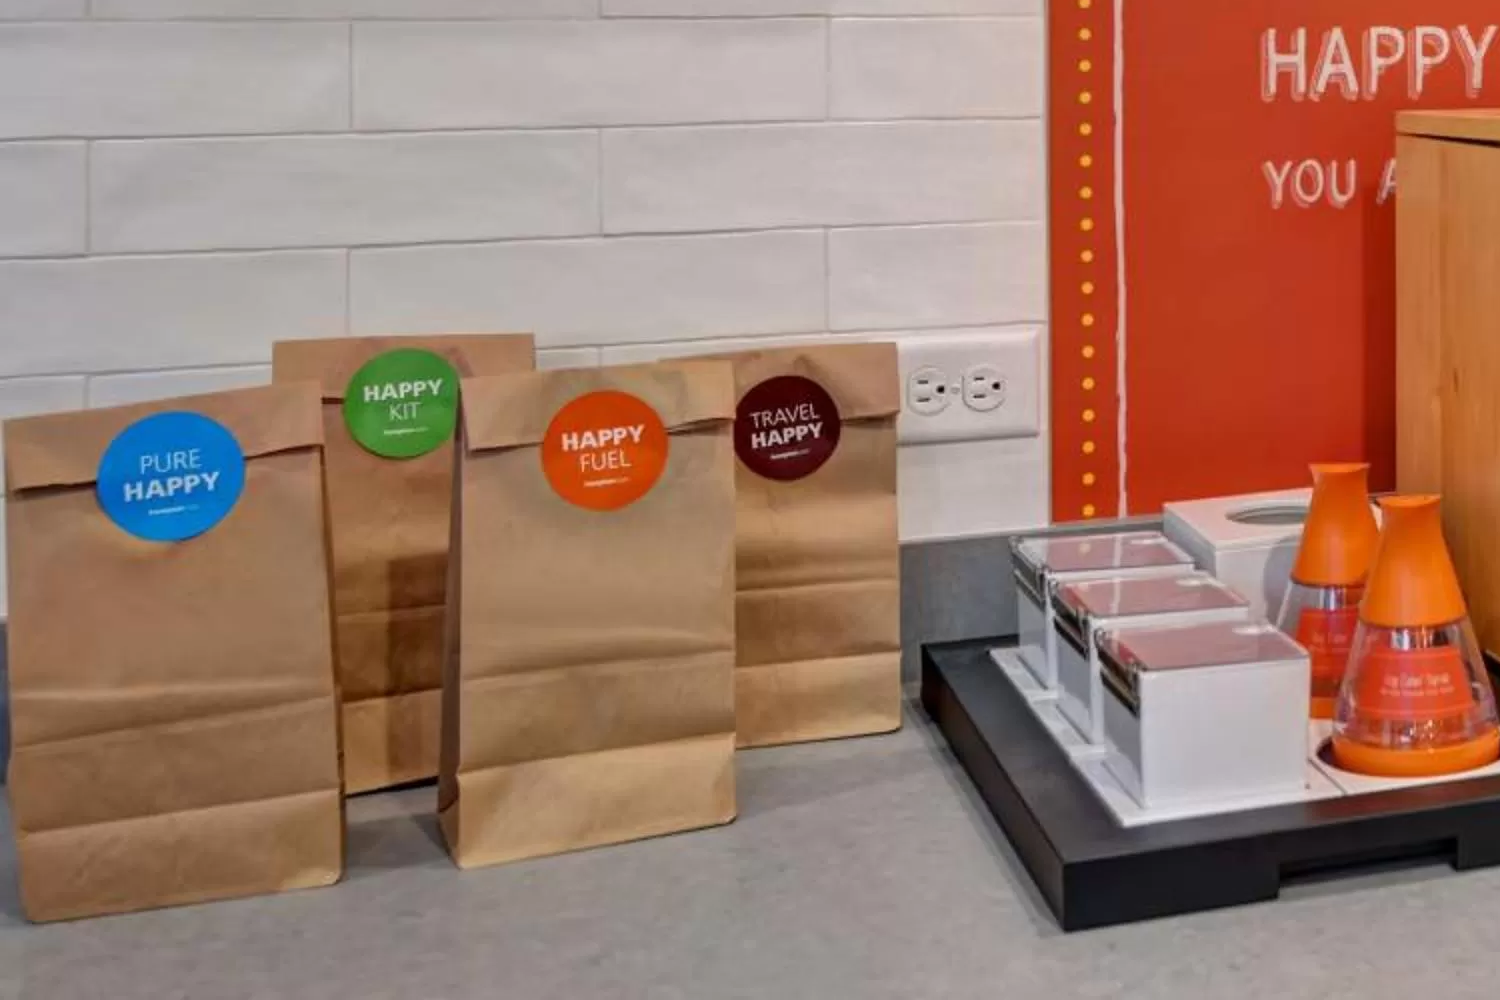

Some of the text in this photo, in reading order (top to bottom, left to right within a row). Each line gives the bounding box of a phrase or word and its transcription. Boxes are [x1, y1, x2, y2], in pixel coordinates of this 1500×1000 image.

[1260, 23, 1499, 103] HAPPY
[1260, 158, 1357, 210] YOU
[363, 378, 443, 402] HAPPY
[389, 400, 423, 422] KIT
[750, 402, 821, 430] TRAVEL
[561, 423, 646, 452] HAPPY
[751, 421, 824, 450] HAPPY
[139, 447, 203, 474] PURE
[579, 448, 632, 473] FUEL
[123, 471, 220, 503] HAPPY
